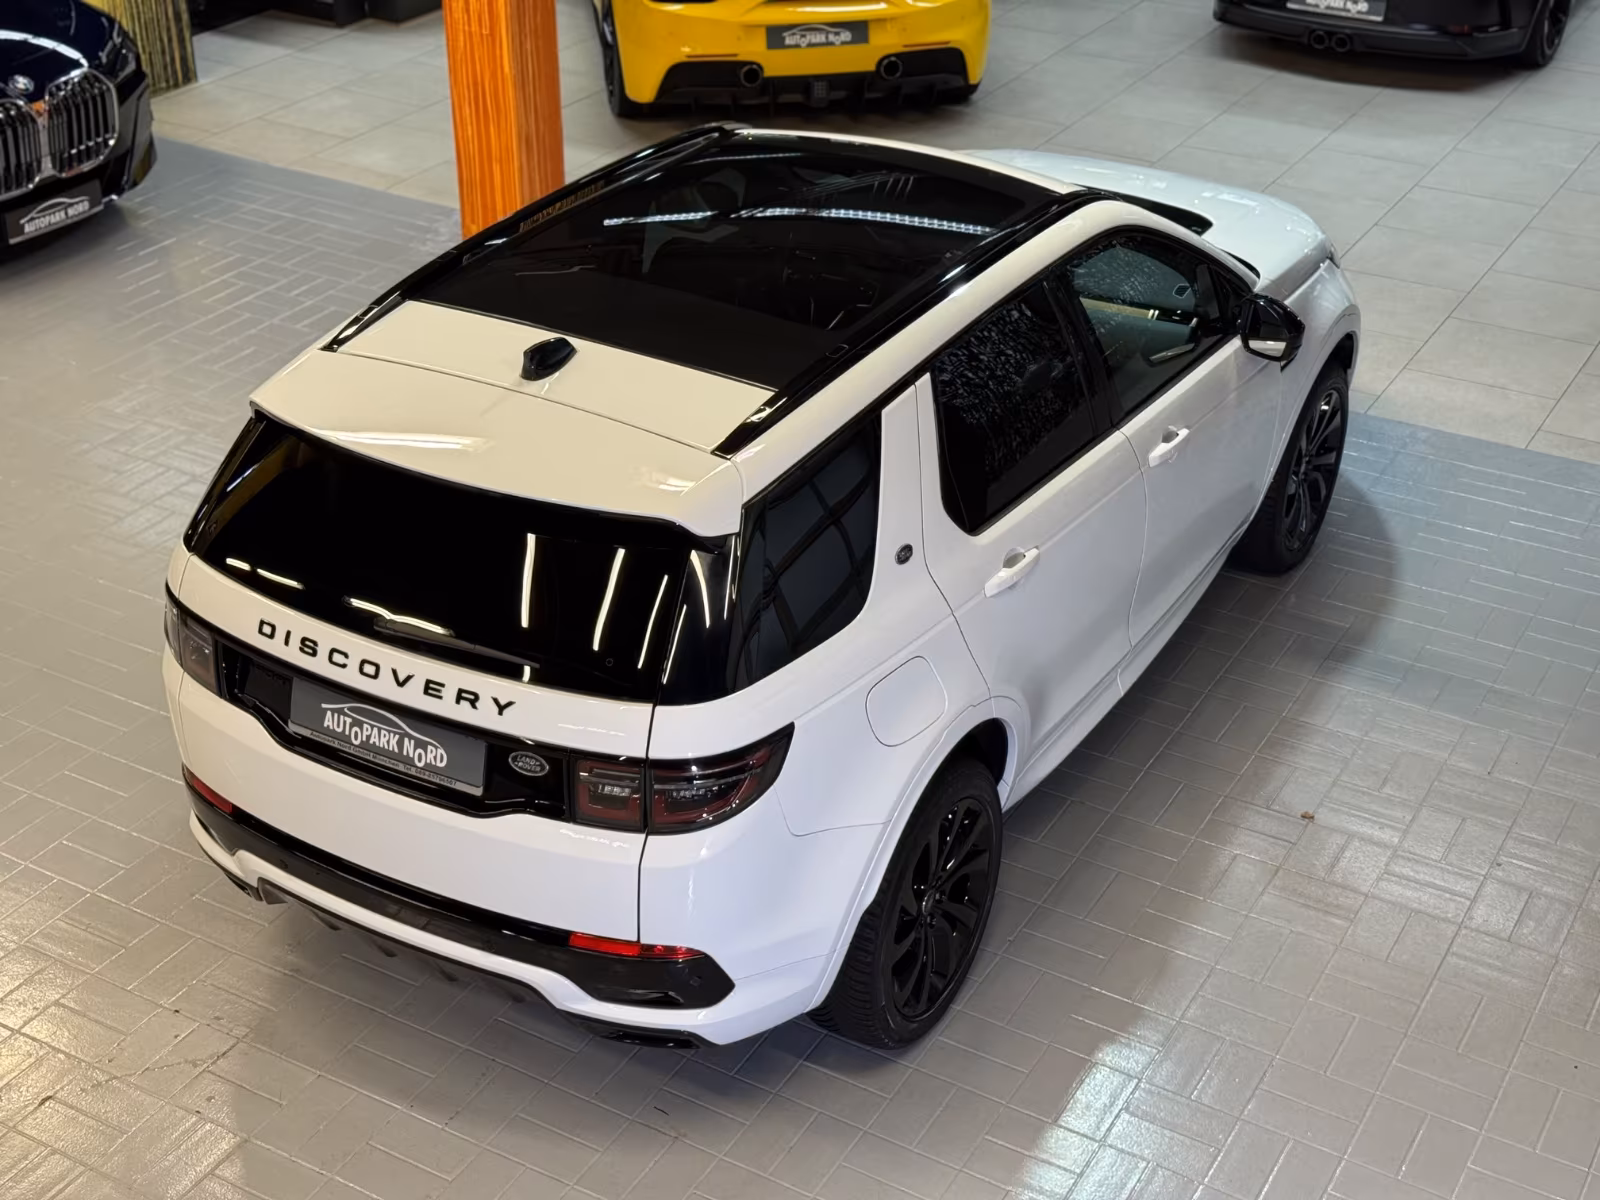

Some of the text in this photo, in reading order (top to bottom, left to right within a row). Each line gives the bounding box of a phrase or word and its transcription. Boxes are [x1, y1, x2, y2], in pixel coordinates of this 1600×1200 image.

[784, 30, 852, 48] AUTOPARK NORD
[24, 200, 90, 233] AUTOPARK NORD
[257, 617, 516, 717] DISCOVERY
[323, 710, 448, 767] AUTOPARK NORD
[337, 741, 352, 752] Nord
[516, 754, 536, 765] LAND
[518, 761, 541, 771] ROVER
